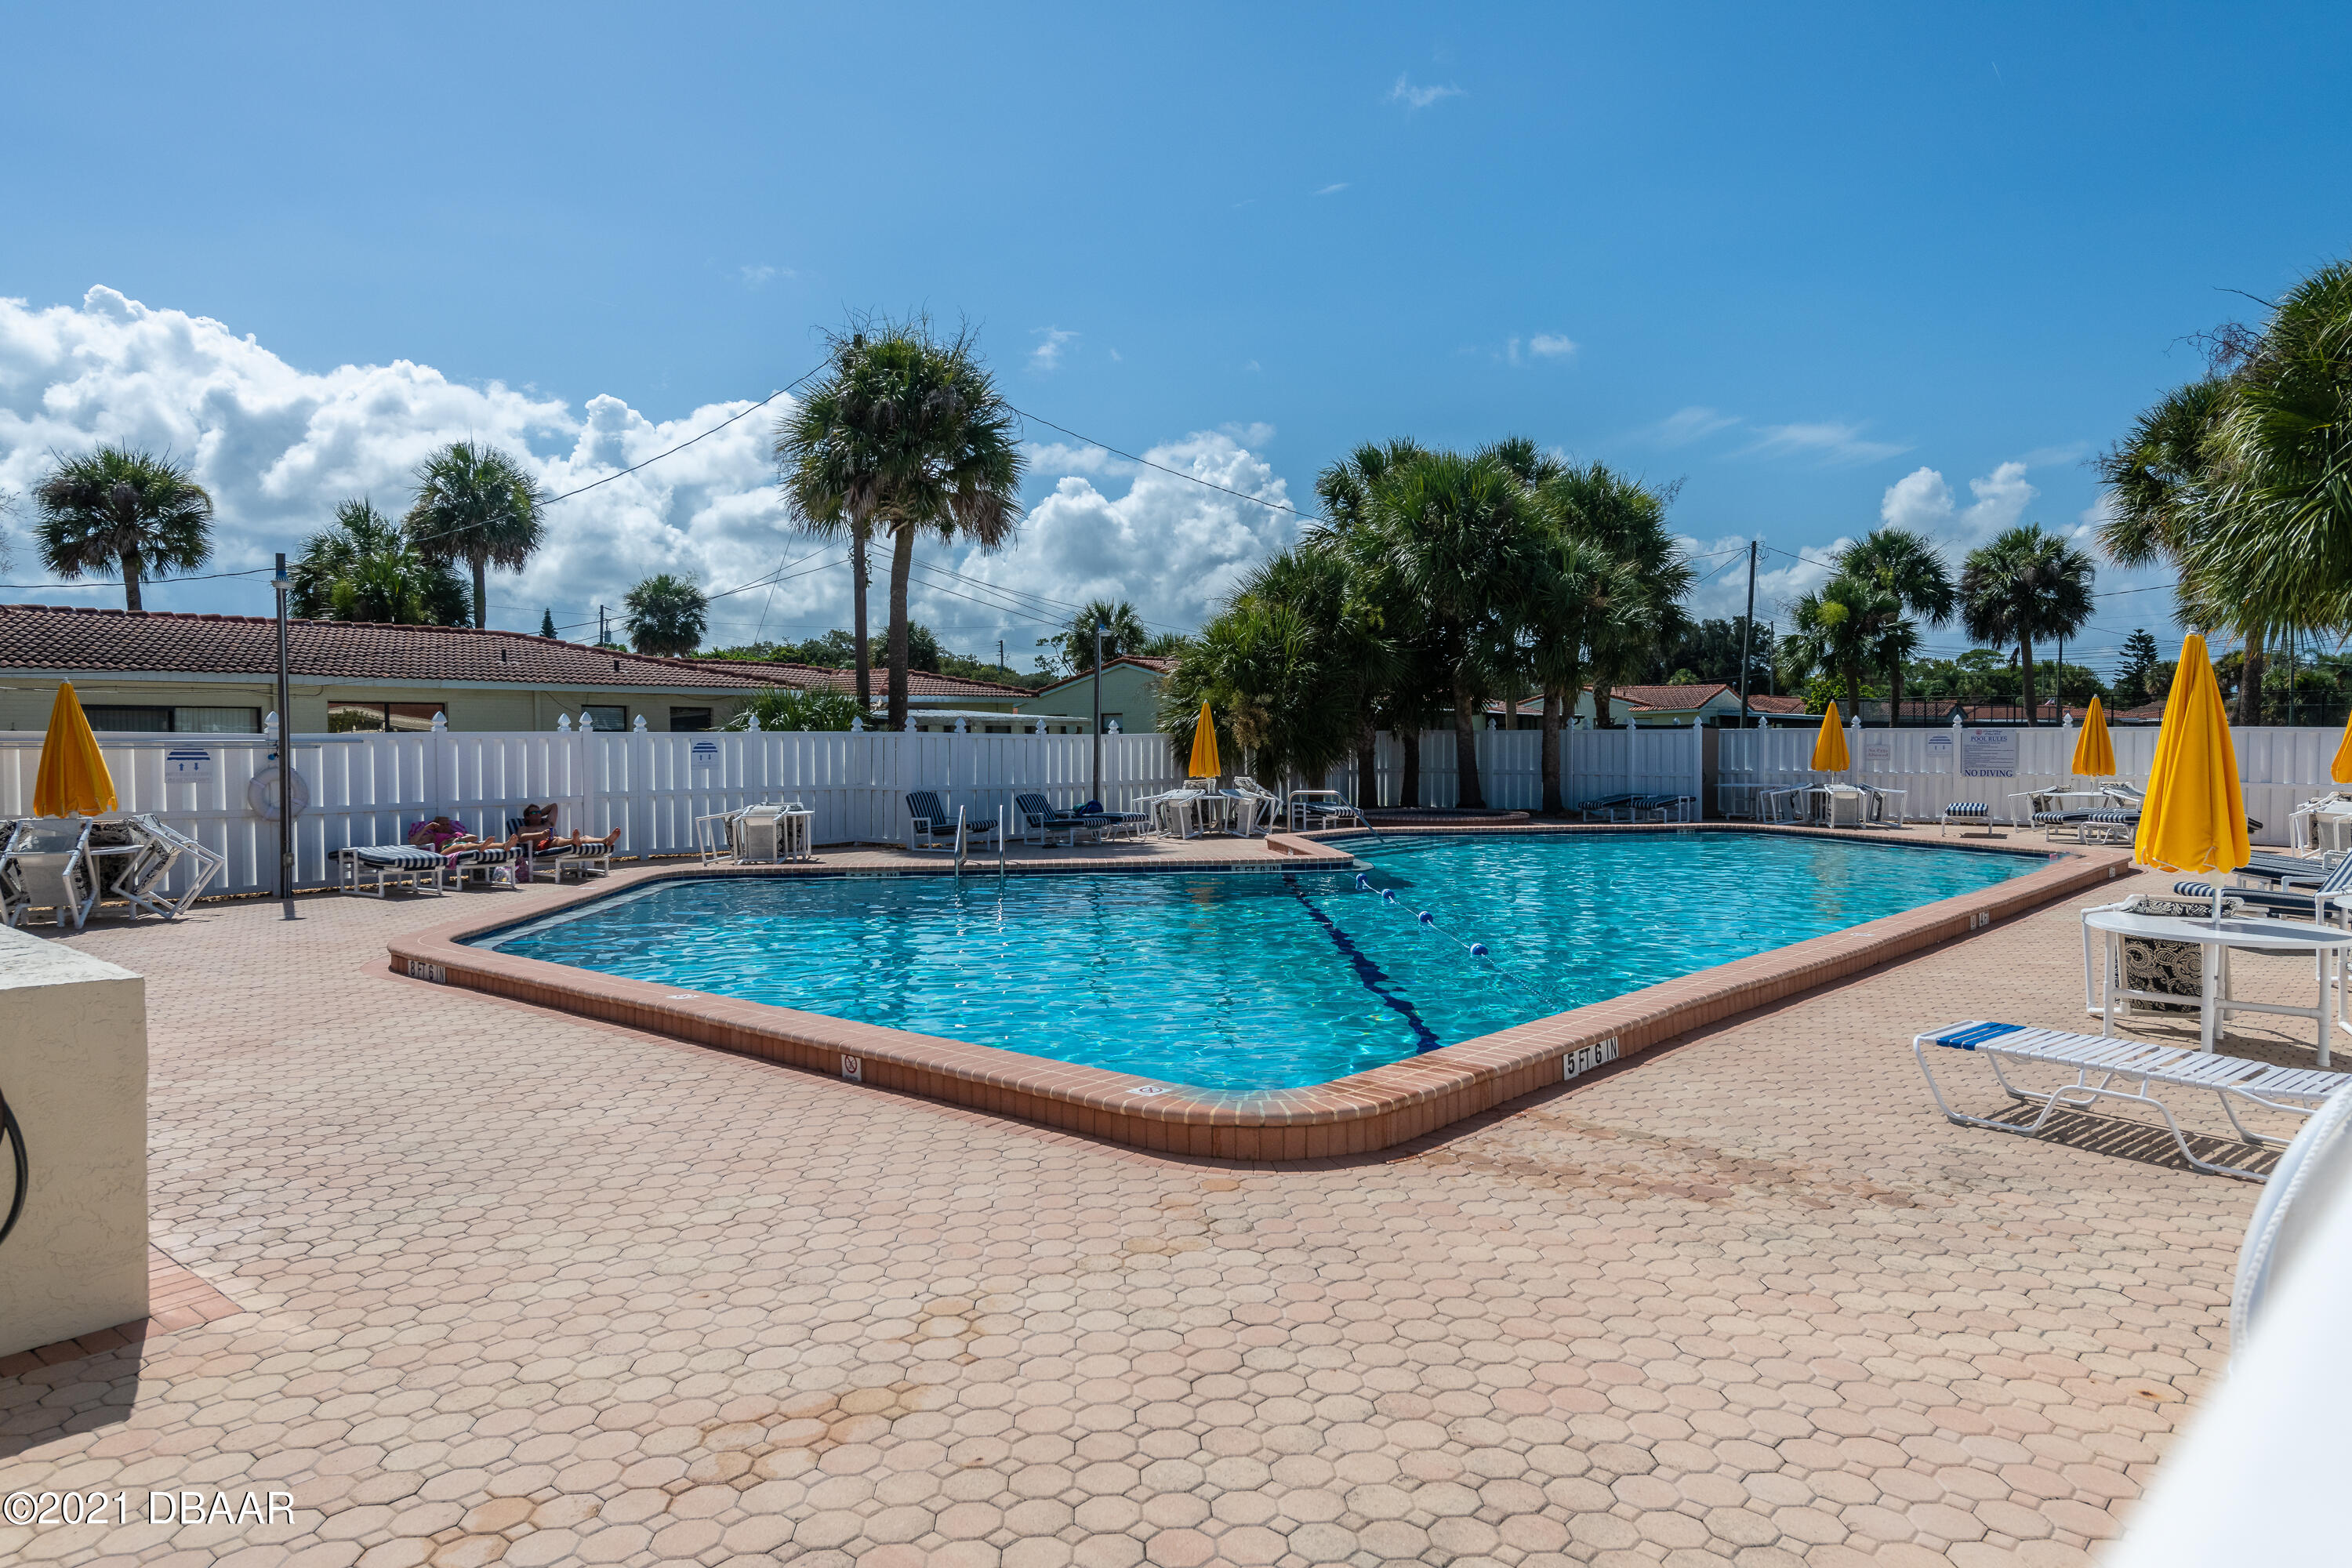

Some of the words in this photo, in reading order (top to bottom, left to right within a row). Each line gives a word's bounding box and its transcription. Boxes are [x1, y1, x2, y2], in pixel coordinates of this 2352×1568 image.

[410, 960, 416, 975] 8
[417, 962, 426, 978] FT
[428, 964, 434, 980] 6
[436, 965, 445, 982] IN
[1567, 1052, 1575, 1074] 5
[1578, 1047, 1591, 1072] FT
[1595, 1043, 1602, 1064] 6
[1605, 1036, 1617, 1060] IN
